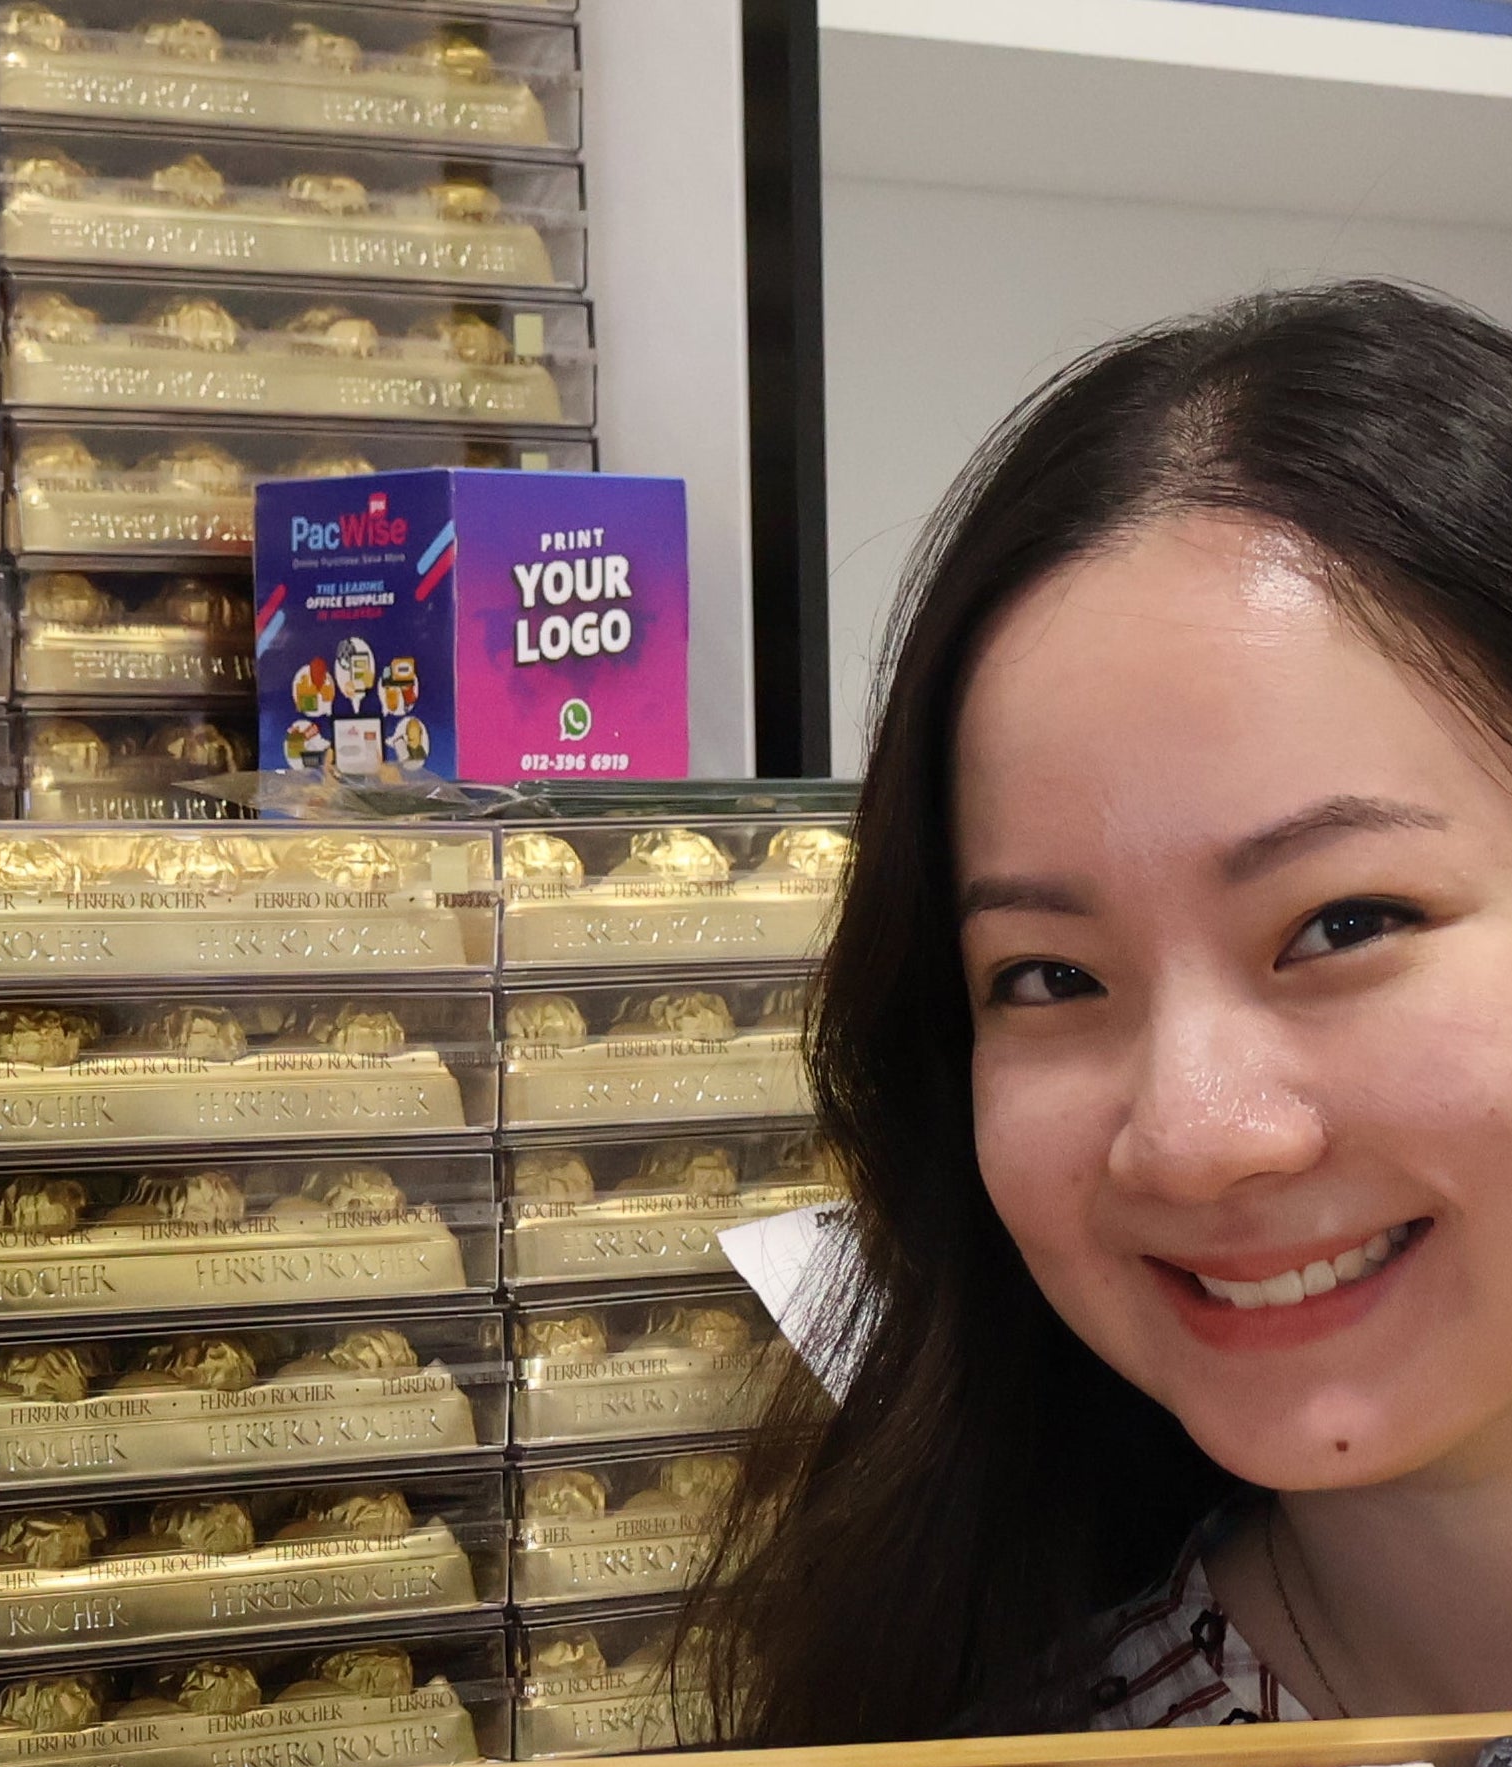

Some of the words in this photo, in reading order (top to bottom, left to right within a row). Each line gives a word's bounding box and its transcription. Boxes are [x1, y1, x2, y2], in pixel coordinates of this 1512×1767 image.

[291, 514, 408, 552] PacWise
[540, 527, 604, 552] PRINT
[316, 583, 336, 595] THE
[339, 580, 384, 594] LEADING
[513, 554, 632, 608] YOUR
[306, 596, 343, 610] OFFICE
[345, 592, 395, 607] SUPPLIES
[516, 608, 631, 663] LOGO
[520, 754, 586, 771] 012-396
[590, 754, 629, 771] 6919
[67, 892, 135, 910] FERRERO
[140, 892, 207, 909] ROCHER
[255, 892, 320, 909] FERRERO
[325, 892, 388, 909] ROCHER
[69, 1058, 137, 1077] FERRERO
[142, 1057, 209, 1075] ROCHER
[258, 1053, 323, 1072] FERRERO
[328, 1053, 392, 1070] ROCHER
[607, 1041, 666, 1058] FERRERO
[671, 1039, 729, 1057] ROCHER
[142, 1221, 209, 1241] FERRERO
[214, 1216, 279, 1236] ROCHER
[327, 1209, 391, 1228] FERRERO
[517, 1201, 577, 1219] ROCHER
[622, 1195, 682, 1213] FERRERO
[686, 1193, 743, 1211] ROCHER
[196, 1255, 313, 1288] FERRERO
[319, 1247, 430, 1280] ROCHER
[546, 1361, 607, 1382] FERRERO
[611, 1358, 671, 1378] ROCHER
[11, 1402, 79, 1425] FERRERO
[84, 1399, 152, 1420] ROCHER
[200, 1391, 266, 1410] FERRERO
[271, 1384, 336, 1404] ROCHER
[382, 1375, 445, 1397] FERRERO
[207, 1418, 324, 1456] FERRERO
[331, 1408, 443, 1446] ROCHER
[7, 1433, 128, 1472] ROCHER
[616, 1518, 676, 1538] FERRERO
[89, 1559, 156, 1581] FERRERO
[162, 1552, 228, 1574] ROCHER
[275, 1540, 340, 1562] FERRERO
[345, 1534, 409, 1556] ROCHER
[570, 1544, 678, 1584] FERRERO
[209, 1577, 324, 1618] FERRERO
[333, 1565, 444, 1605] ROCHER
[9, 1596, 130, 1638] ROCHER
[568, 1672, 629, 1695] ROCHER
[18, 1731, 87, 1756] FERRERO
[92, 1724, 160, 1749] ROCHER
[208, 1711, 274, 1735] FERRERO
[279, 1704, 343, 1727] ROCHER
[389, 1691, 453, 1713] FERRERO
[333, 1725, 444, 1764] ROCHER
